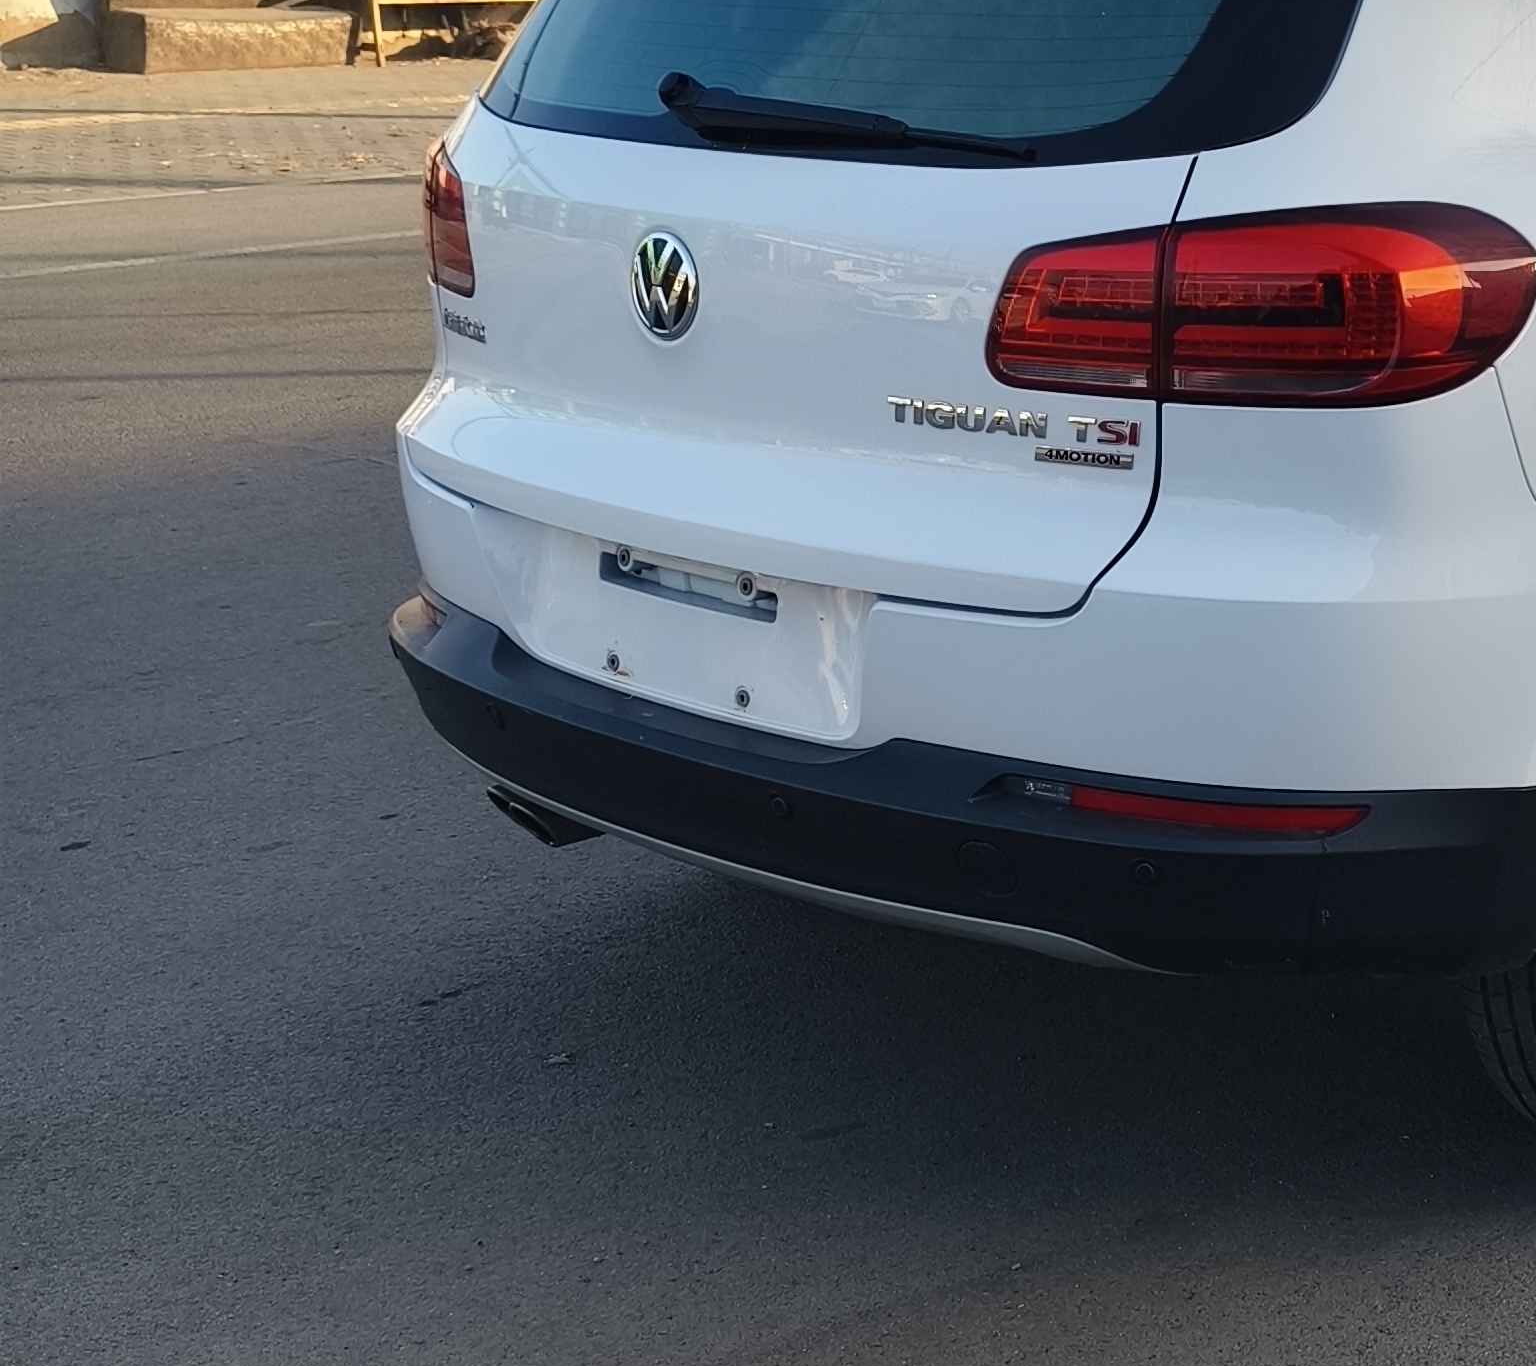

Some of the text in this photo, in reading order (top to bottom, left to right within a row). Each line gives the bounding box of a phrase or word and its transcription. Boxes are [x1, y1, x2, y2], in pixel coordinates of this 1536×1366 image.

[887, 395, 1142, 447] TIGUAN TSI
[1044, 448, 1121, 467] 4MOTION
